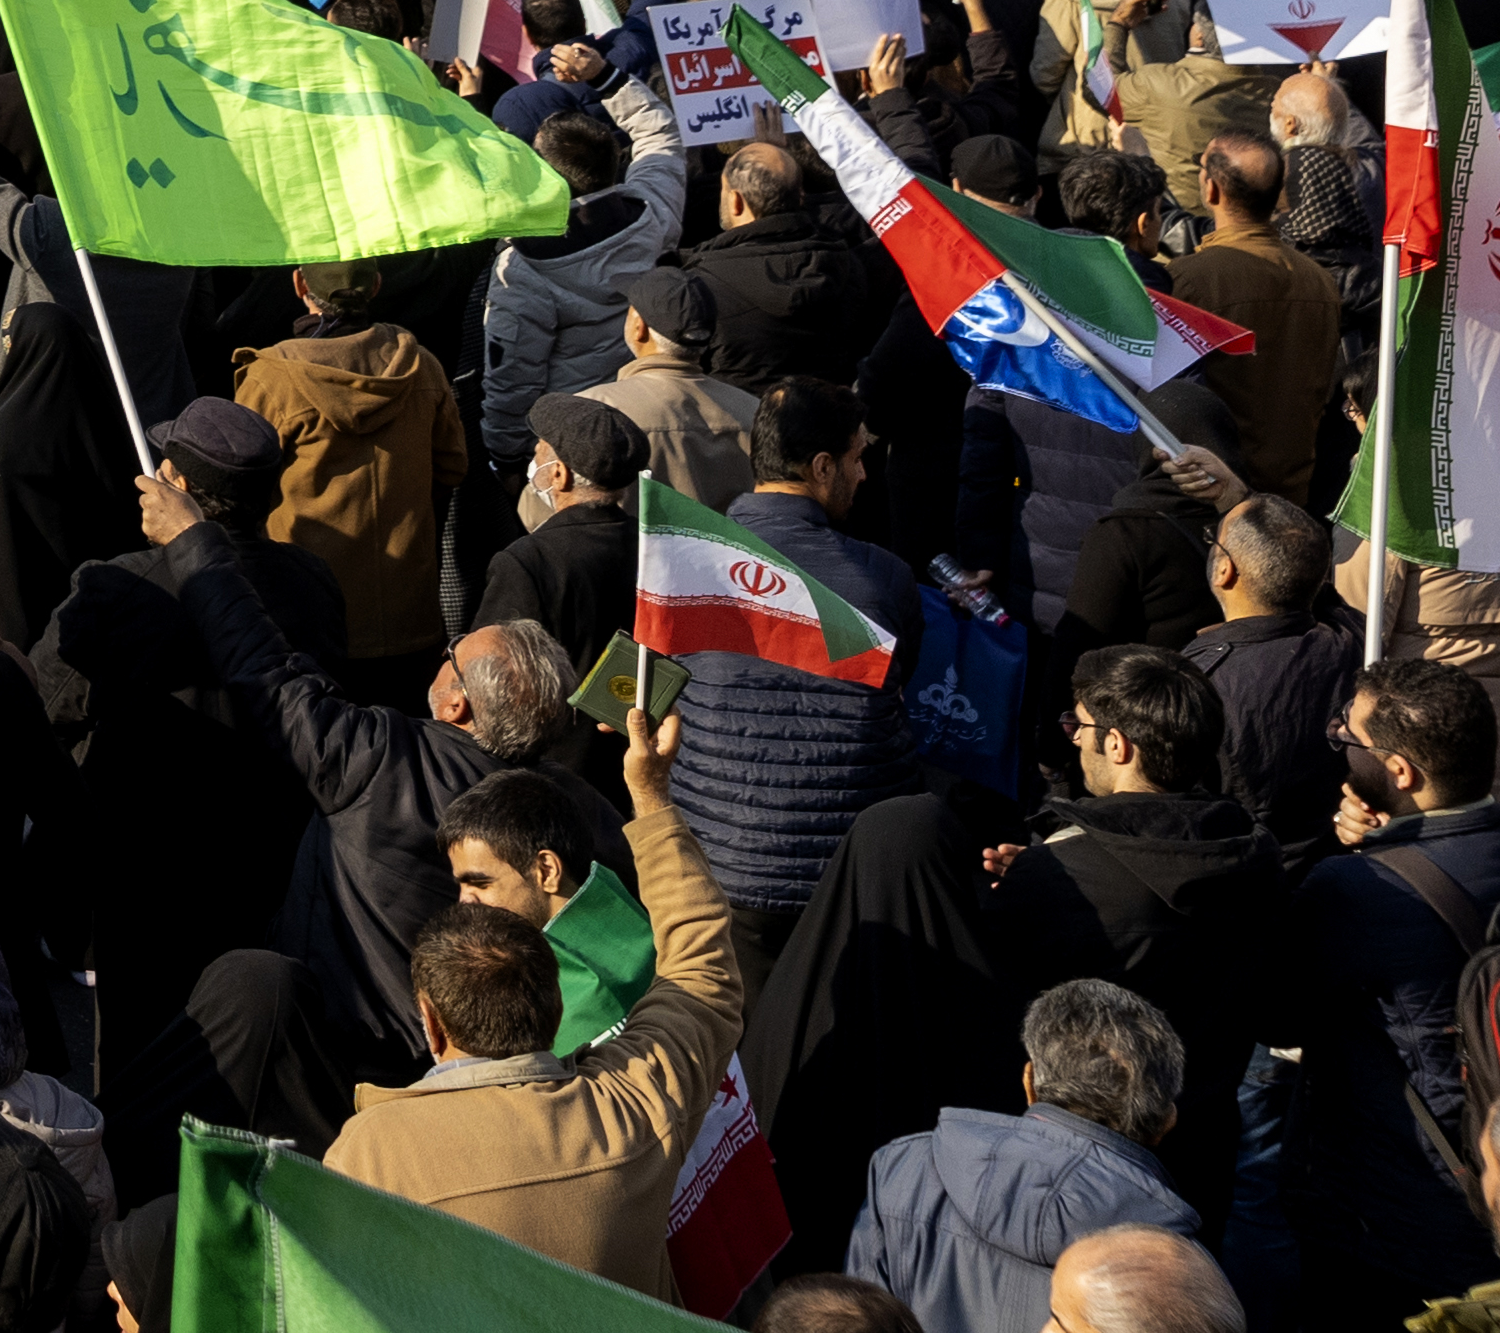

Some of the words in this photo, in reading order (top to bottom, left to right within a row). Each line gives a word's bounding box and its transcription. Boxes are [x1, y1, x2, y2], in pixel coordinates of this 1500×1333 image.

[664, 9, 723, 47] آمریکا
[675, 52, 741, 91] اسرائیل
[687, 92, 750, 133] انگلیس
